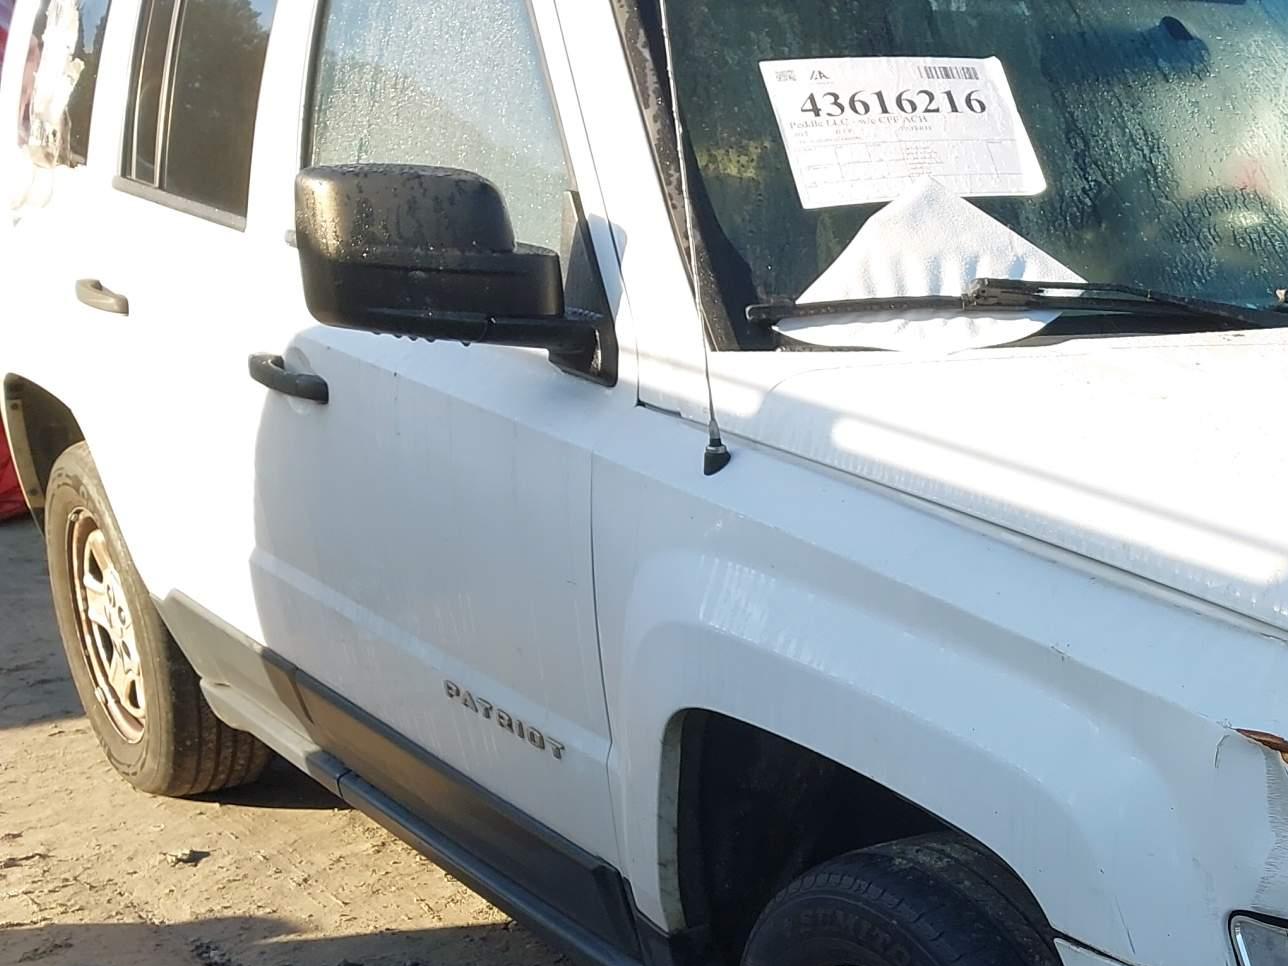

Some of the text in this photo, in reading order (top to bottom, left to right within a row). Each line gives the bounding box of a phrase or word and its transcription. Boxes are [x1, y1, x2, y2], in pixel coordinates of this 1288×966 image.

[800, 88, 987, 118] 43616216
[826, 118, 848, 128] LLC
[444, 679, 566, 760] PATRIOT
